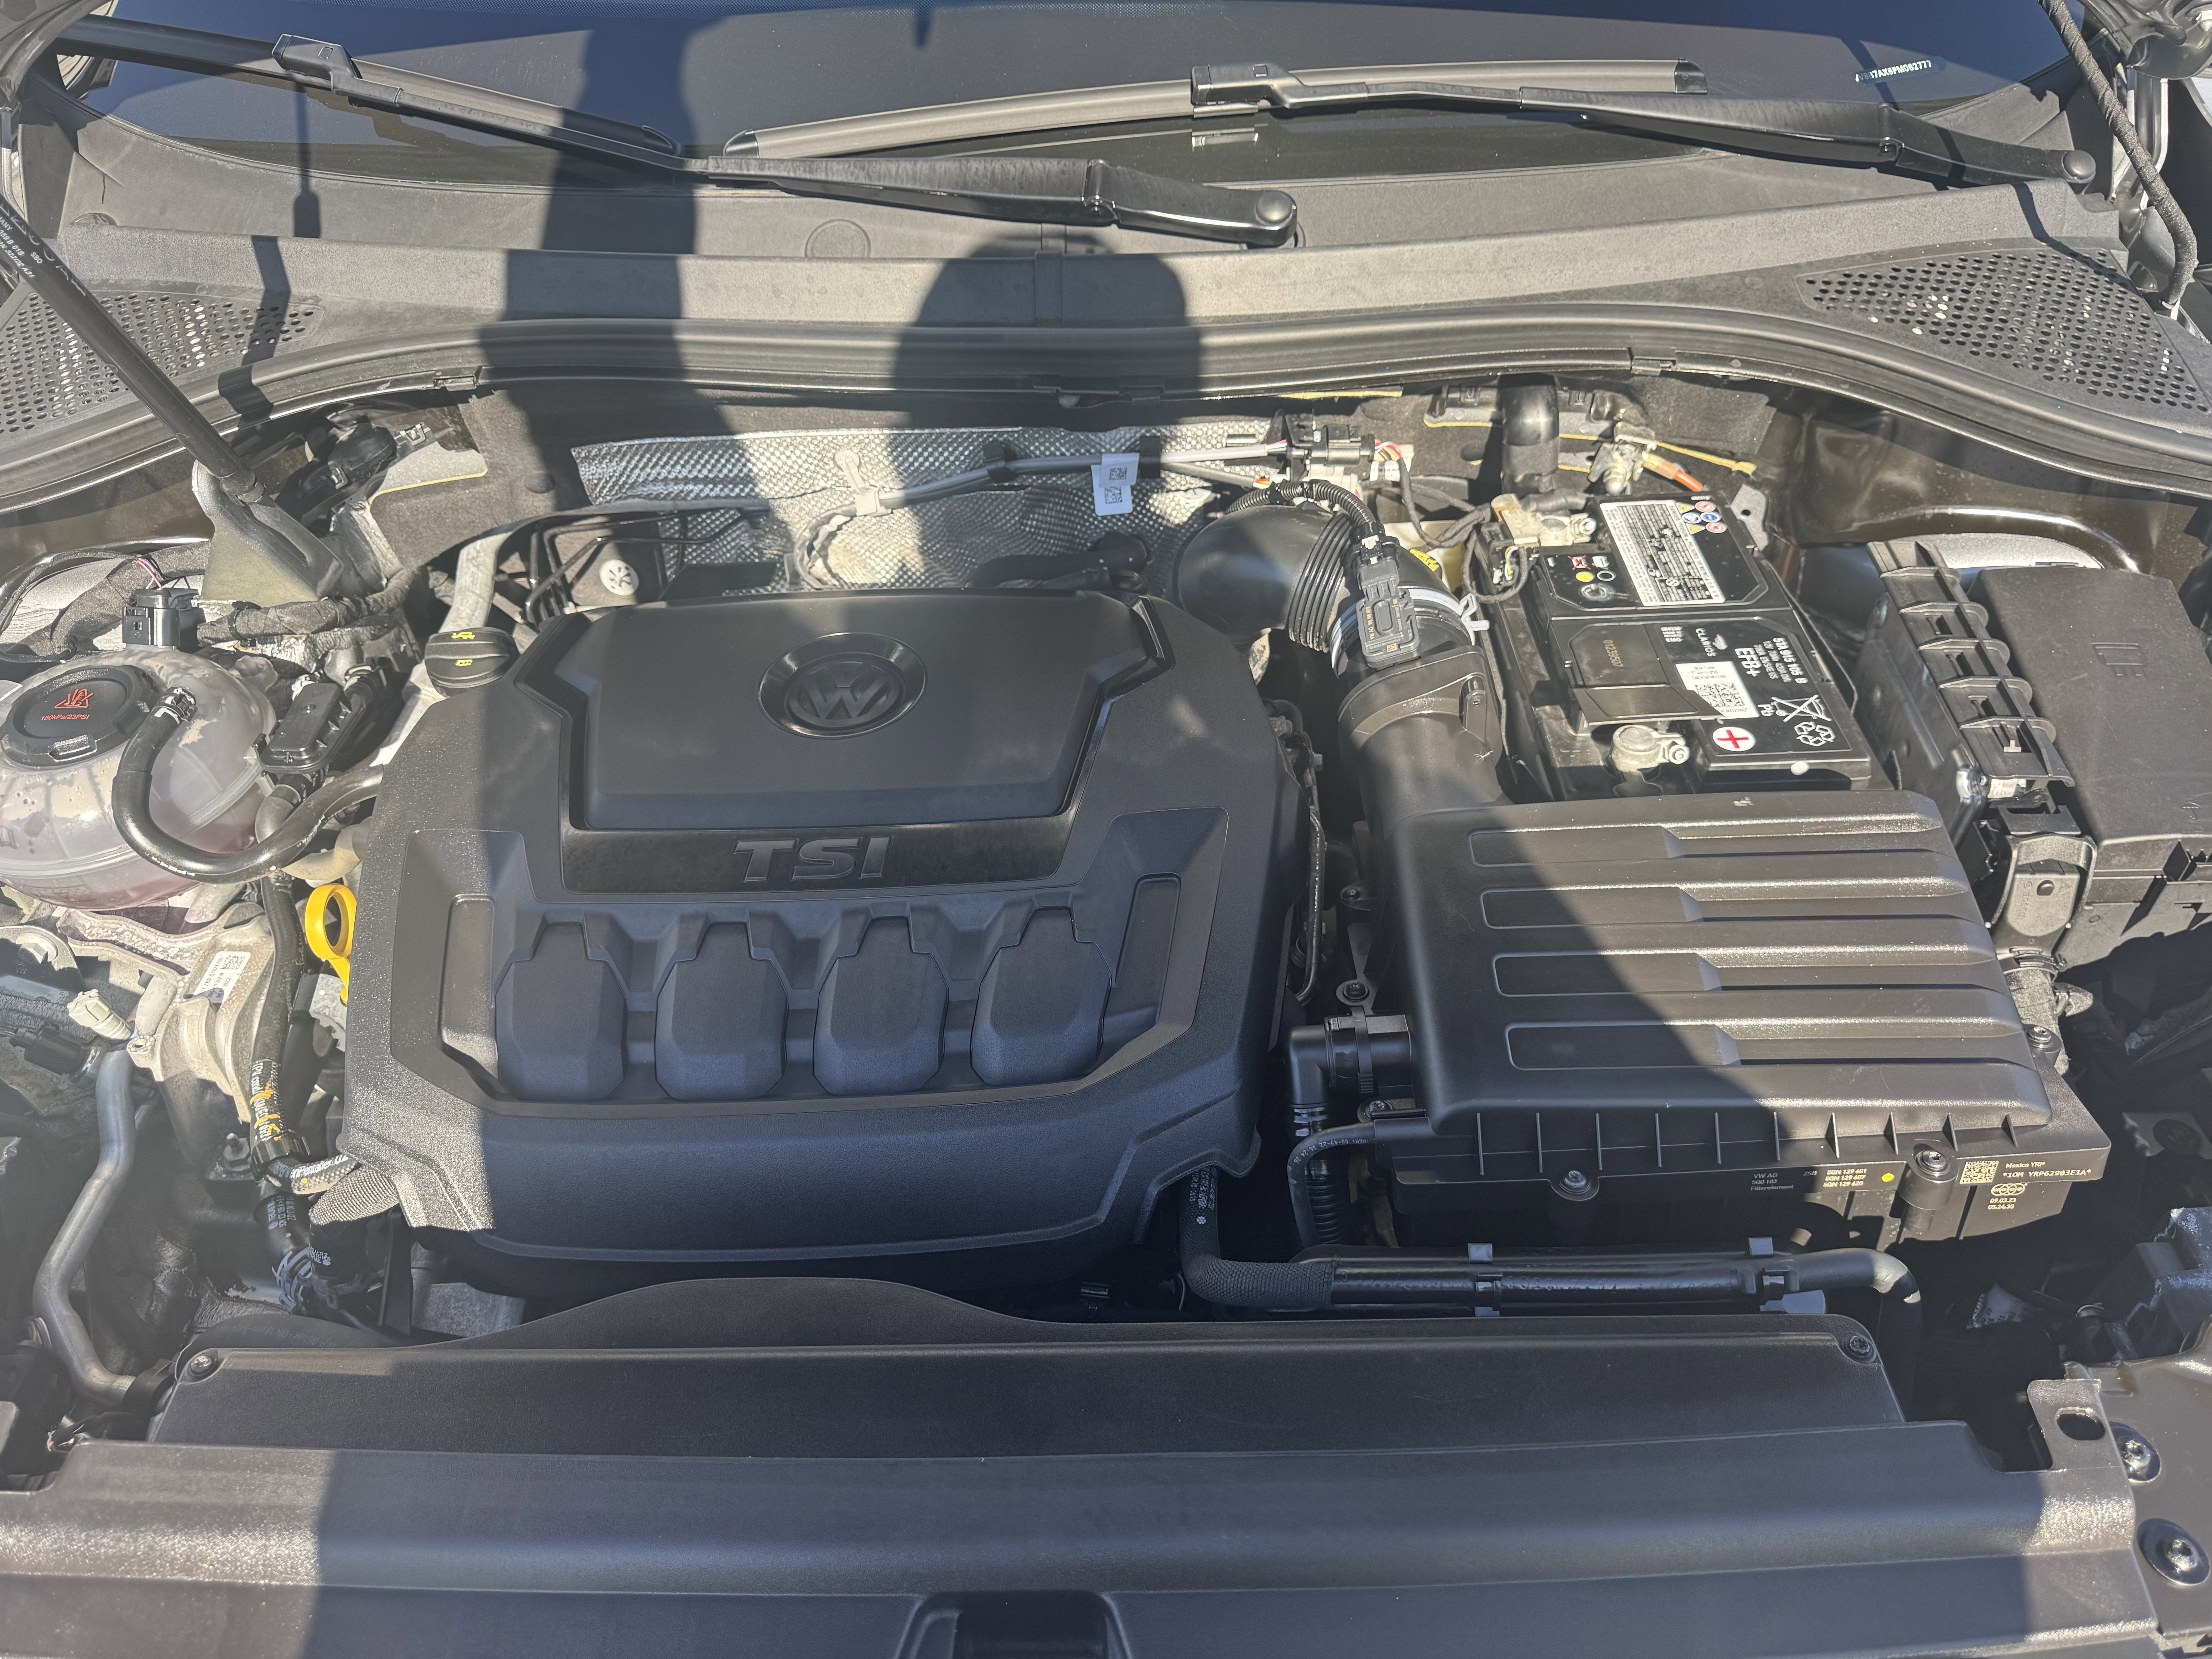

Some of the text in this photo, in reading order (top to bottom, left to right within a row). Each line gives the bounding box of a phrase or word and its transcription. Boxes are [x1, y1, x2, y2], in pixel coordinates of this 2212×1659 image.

[1695, 628, 1717, 657] CLARIOS
[1780, 650, 1796, 662] 915
[1735, 647, 1762, 677] EFB+
[1758, 703, 1775, 717] Pb
[733, 836, 893, 882] TSI
